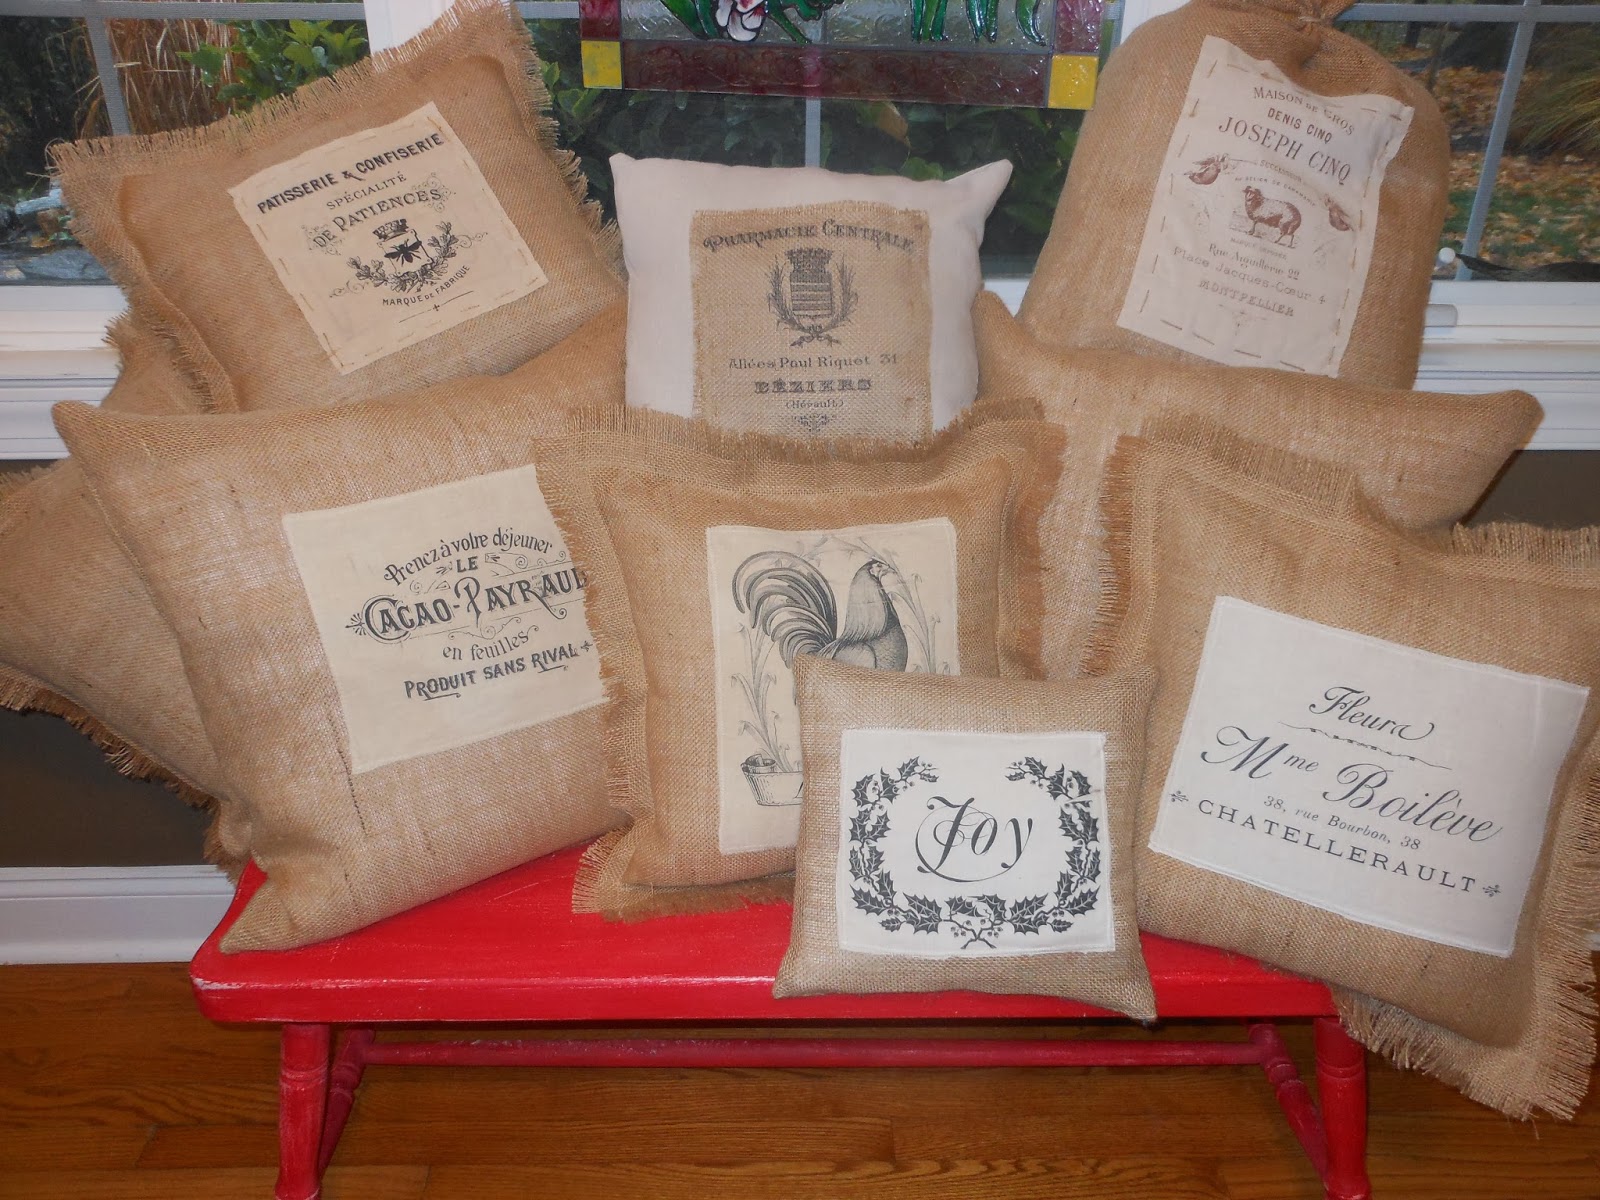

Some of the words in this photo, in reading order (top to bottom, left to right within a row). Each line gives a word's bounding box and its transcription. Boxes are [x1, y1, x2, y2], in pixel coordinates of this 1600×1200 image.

[1254, 86, 1303, 105] MAISON
[1267, 107, 1302, 130] DENIS
[1306, 124, 1333, 144] CINQ
[1218, 116, 1304, 160] JOSEPH
[1308, 151, 1351, 186] CINQ
[256, 172, 339, 215] PATISSERIE
[341, 169, 363, 182] &
[355, 133, 445, 174] CONFISERIE
[325, 171, 408, 211] SPÉCIALITÉ
[313, 228, 337, 249] DE
[332, 188, 443, 232] PATIENCES
[703, 224, 818, 252] PHARMACIE
[822, 218, 916, 252] CENTRALE
[1173, 245, 1211, 269] Place
[382, 293, 424, 308] MARQUE
[434, 264, 471, 296] FABRIQUE
[1198, 279, 1295, 317] MONTPELLIER
[779, 355, 813, 369] Paul
[818, 355, 871, 371] Riquet
[383, 550, 441, 587] Prenez
[450, 531, 489, 553] votre
[492, 527, 553, 554] déjeuner
[455, 555, 479, 574] LE
[442, 645, 464, 662] en
[470, 624, 540, 661] feuilles
[403, 669, 477, 702] PRODUIT
[483, 657, 527, 680] SANS
[531, 642, 580, 674] RIVAL
[1263, 795, 1289, 814] 38,
[1294, 807, 1320, 823] rue
[1327, 814, 1392, 846] Bourbon,
[1400, 835, 1421, 851] 38
[1322, 762, 1504, 843] Boilève
[915, 796, 1034, 882] Joy
[1198, 799, 1477, 894] CHATELLERAULT
